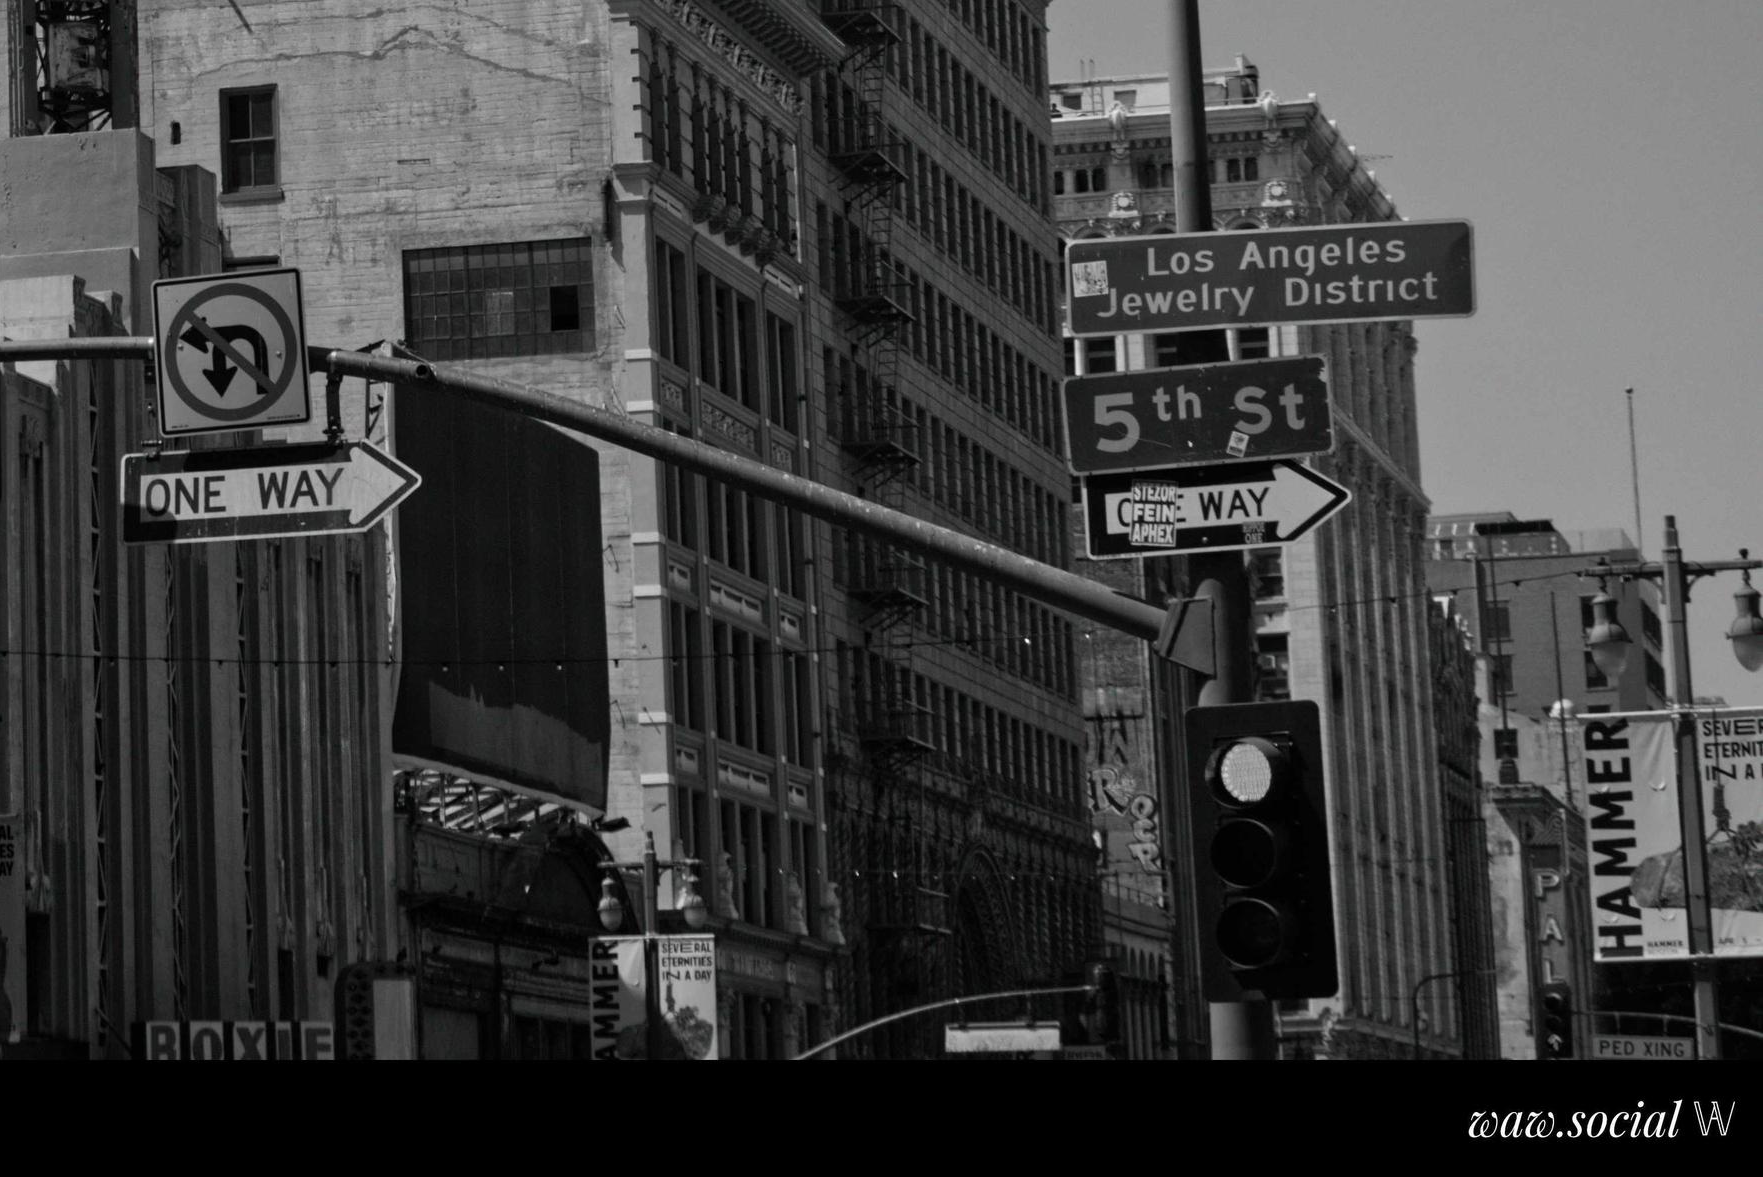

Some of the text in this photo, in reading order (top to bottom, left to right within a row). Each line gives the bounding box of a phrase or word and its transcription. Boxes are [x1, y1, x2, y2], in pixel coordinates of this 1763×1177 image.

[1147, 236, 1407, 276] Los Angeles
[1096, 271, 1439, 318] Jewelry District
[1093, 382, 1307, 454] 5th St
[145, 467, 345, 517] ONE WAY
[1133, 503, 1175, 522] FEIN
[1198, 487, 1270, 522] WAY
[1132, 523, 1174, 544] APHEX
[1704, 742, 1763, 758] ETERNIT
[1705, 764, 1737, 781] IN
[1745, 763, 1755, 779] A
[1584, 717, 1644, 958] HAMMER
[662, 942, 712, 953] SEVERAL
[662, 956, 712, 967] ETERNITIES
[662, 970, 712, 981] IN A DAY
[1599, 1039, 1685, 1057] PED XING
